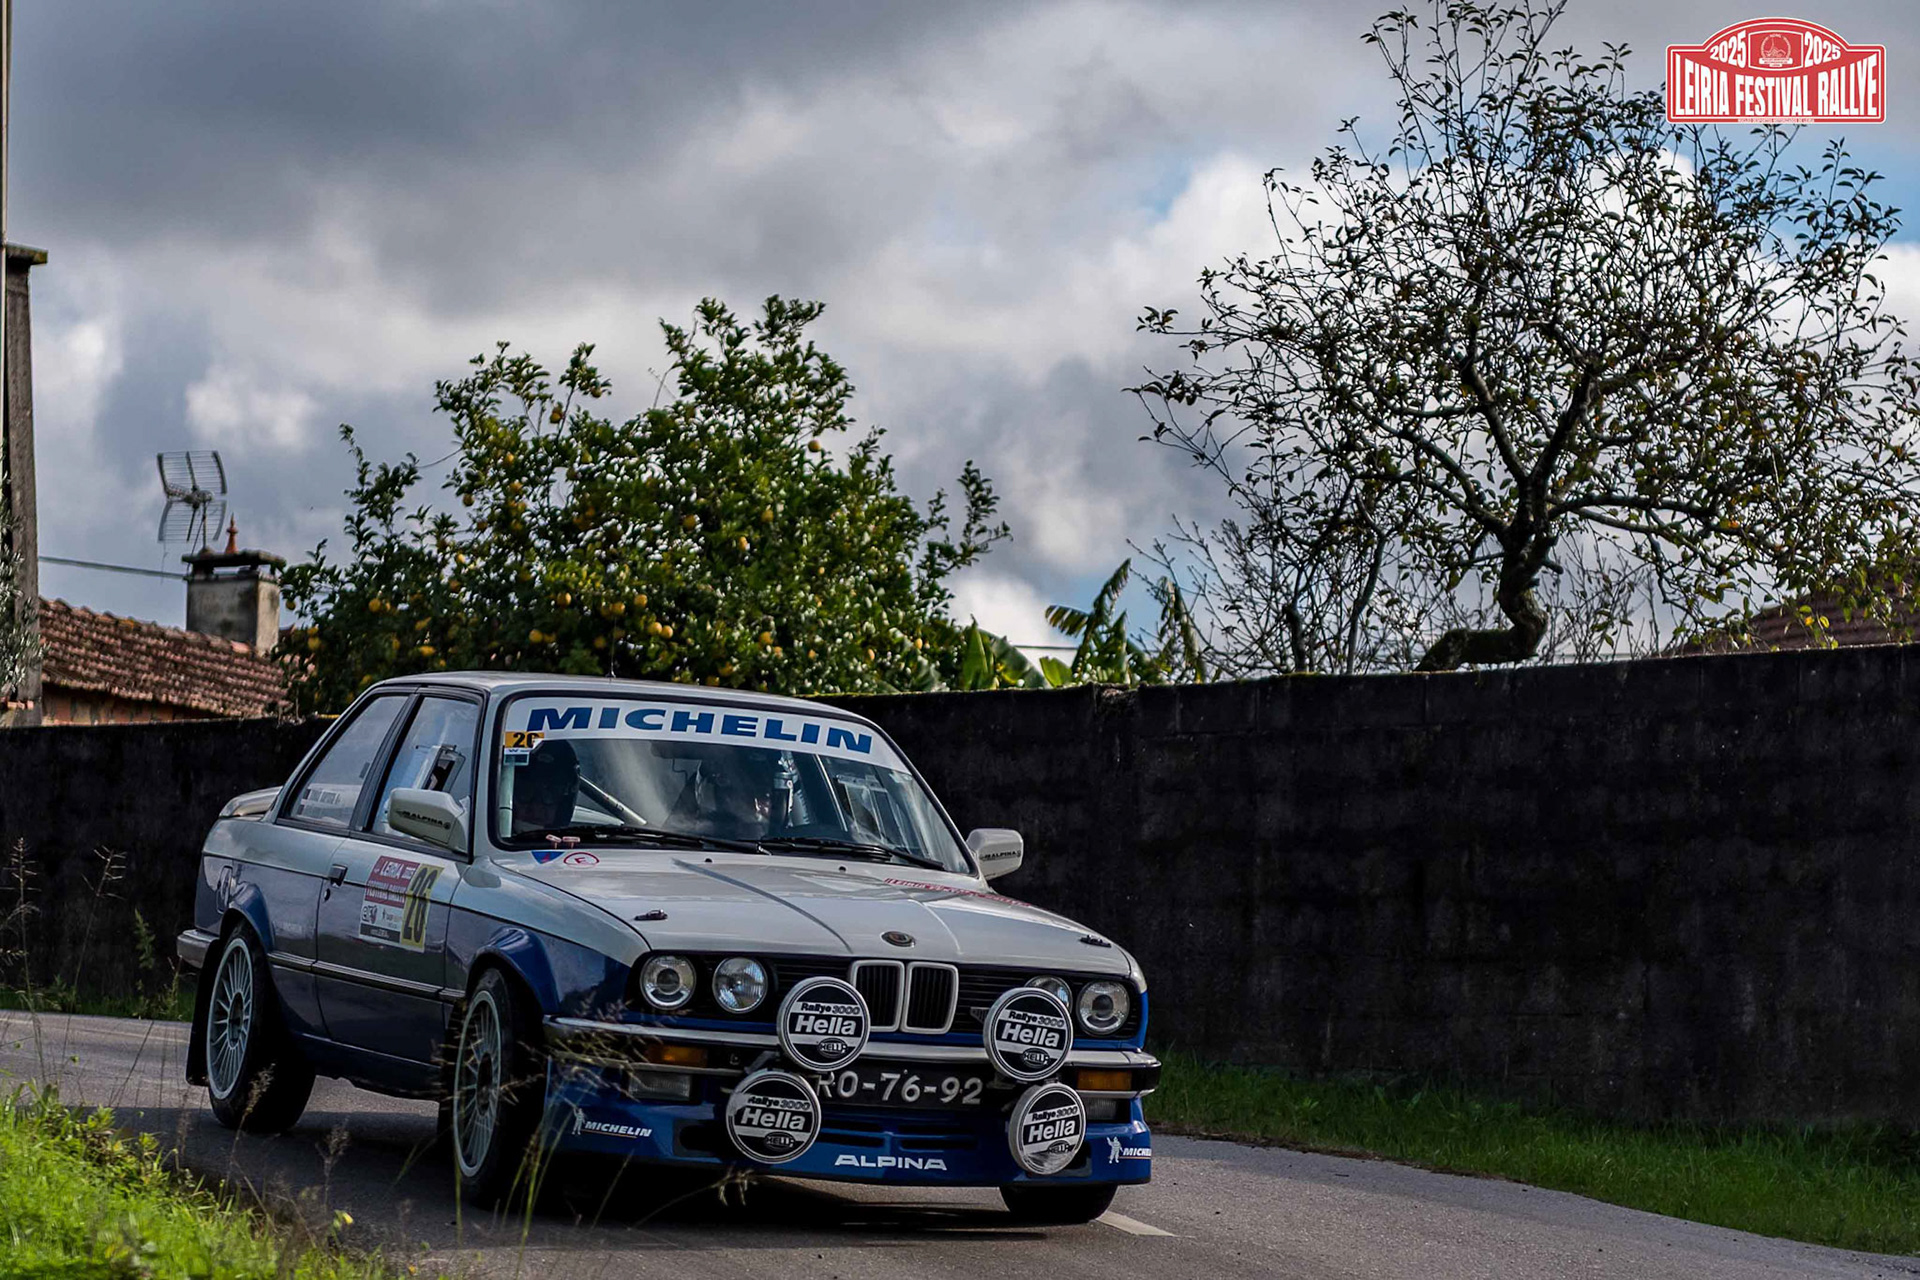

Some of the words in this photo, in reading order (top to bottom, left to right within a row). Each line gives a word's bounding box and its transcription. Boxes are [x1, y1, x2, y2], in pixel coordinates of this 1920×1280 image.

[526, 706, 872, 754] MICHELIN
[403, 867, 438, 943] 26
[801, 1003, 831, 1014] Rallye
[832, 1005, 860, 1015] 3000
[795, 1015, 857, 1035] Hella
[1009, 1011, 1037, 1023] Rallye
[1038, 1016, 1065, 1028] 3000
[1001, 1022, 1060, 1047] Hella
[816, 1071, 983, 1104] RO-76-92
[748, 1096, 779, 1107] Rallye
[780, 1100, 811, 1110] 3000
[740, 1107, 806, 1130] Hella
[1032, 1111, 1055, 1121] Rallye
[1056, 1106, 1078, 1118] 3000
[585, 1121, 652, 1137] MICHELIN
[1028, 1120, 1075, 1142] Hella
[834, 1154, 948, 1171] ALPINA
